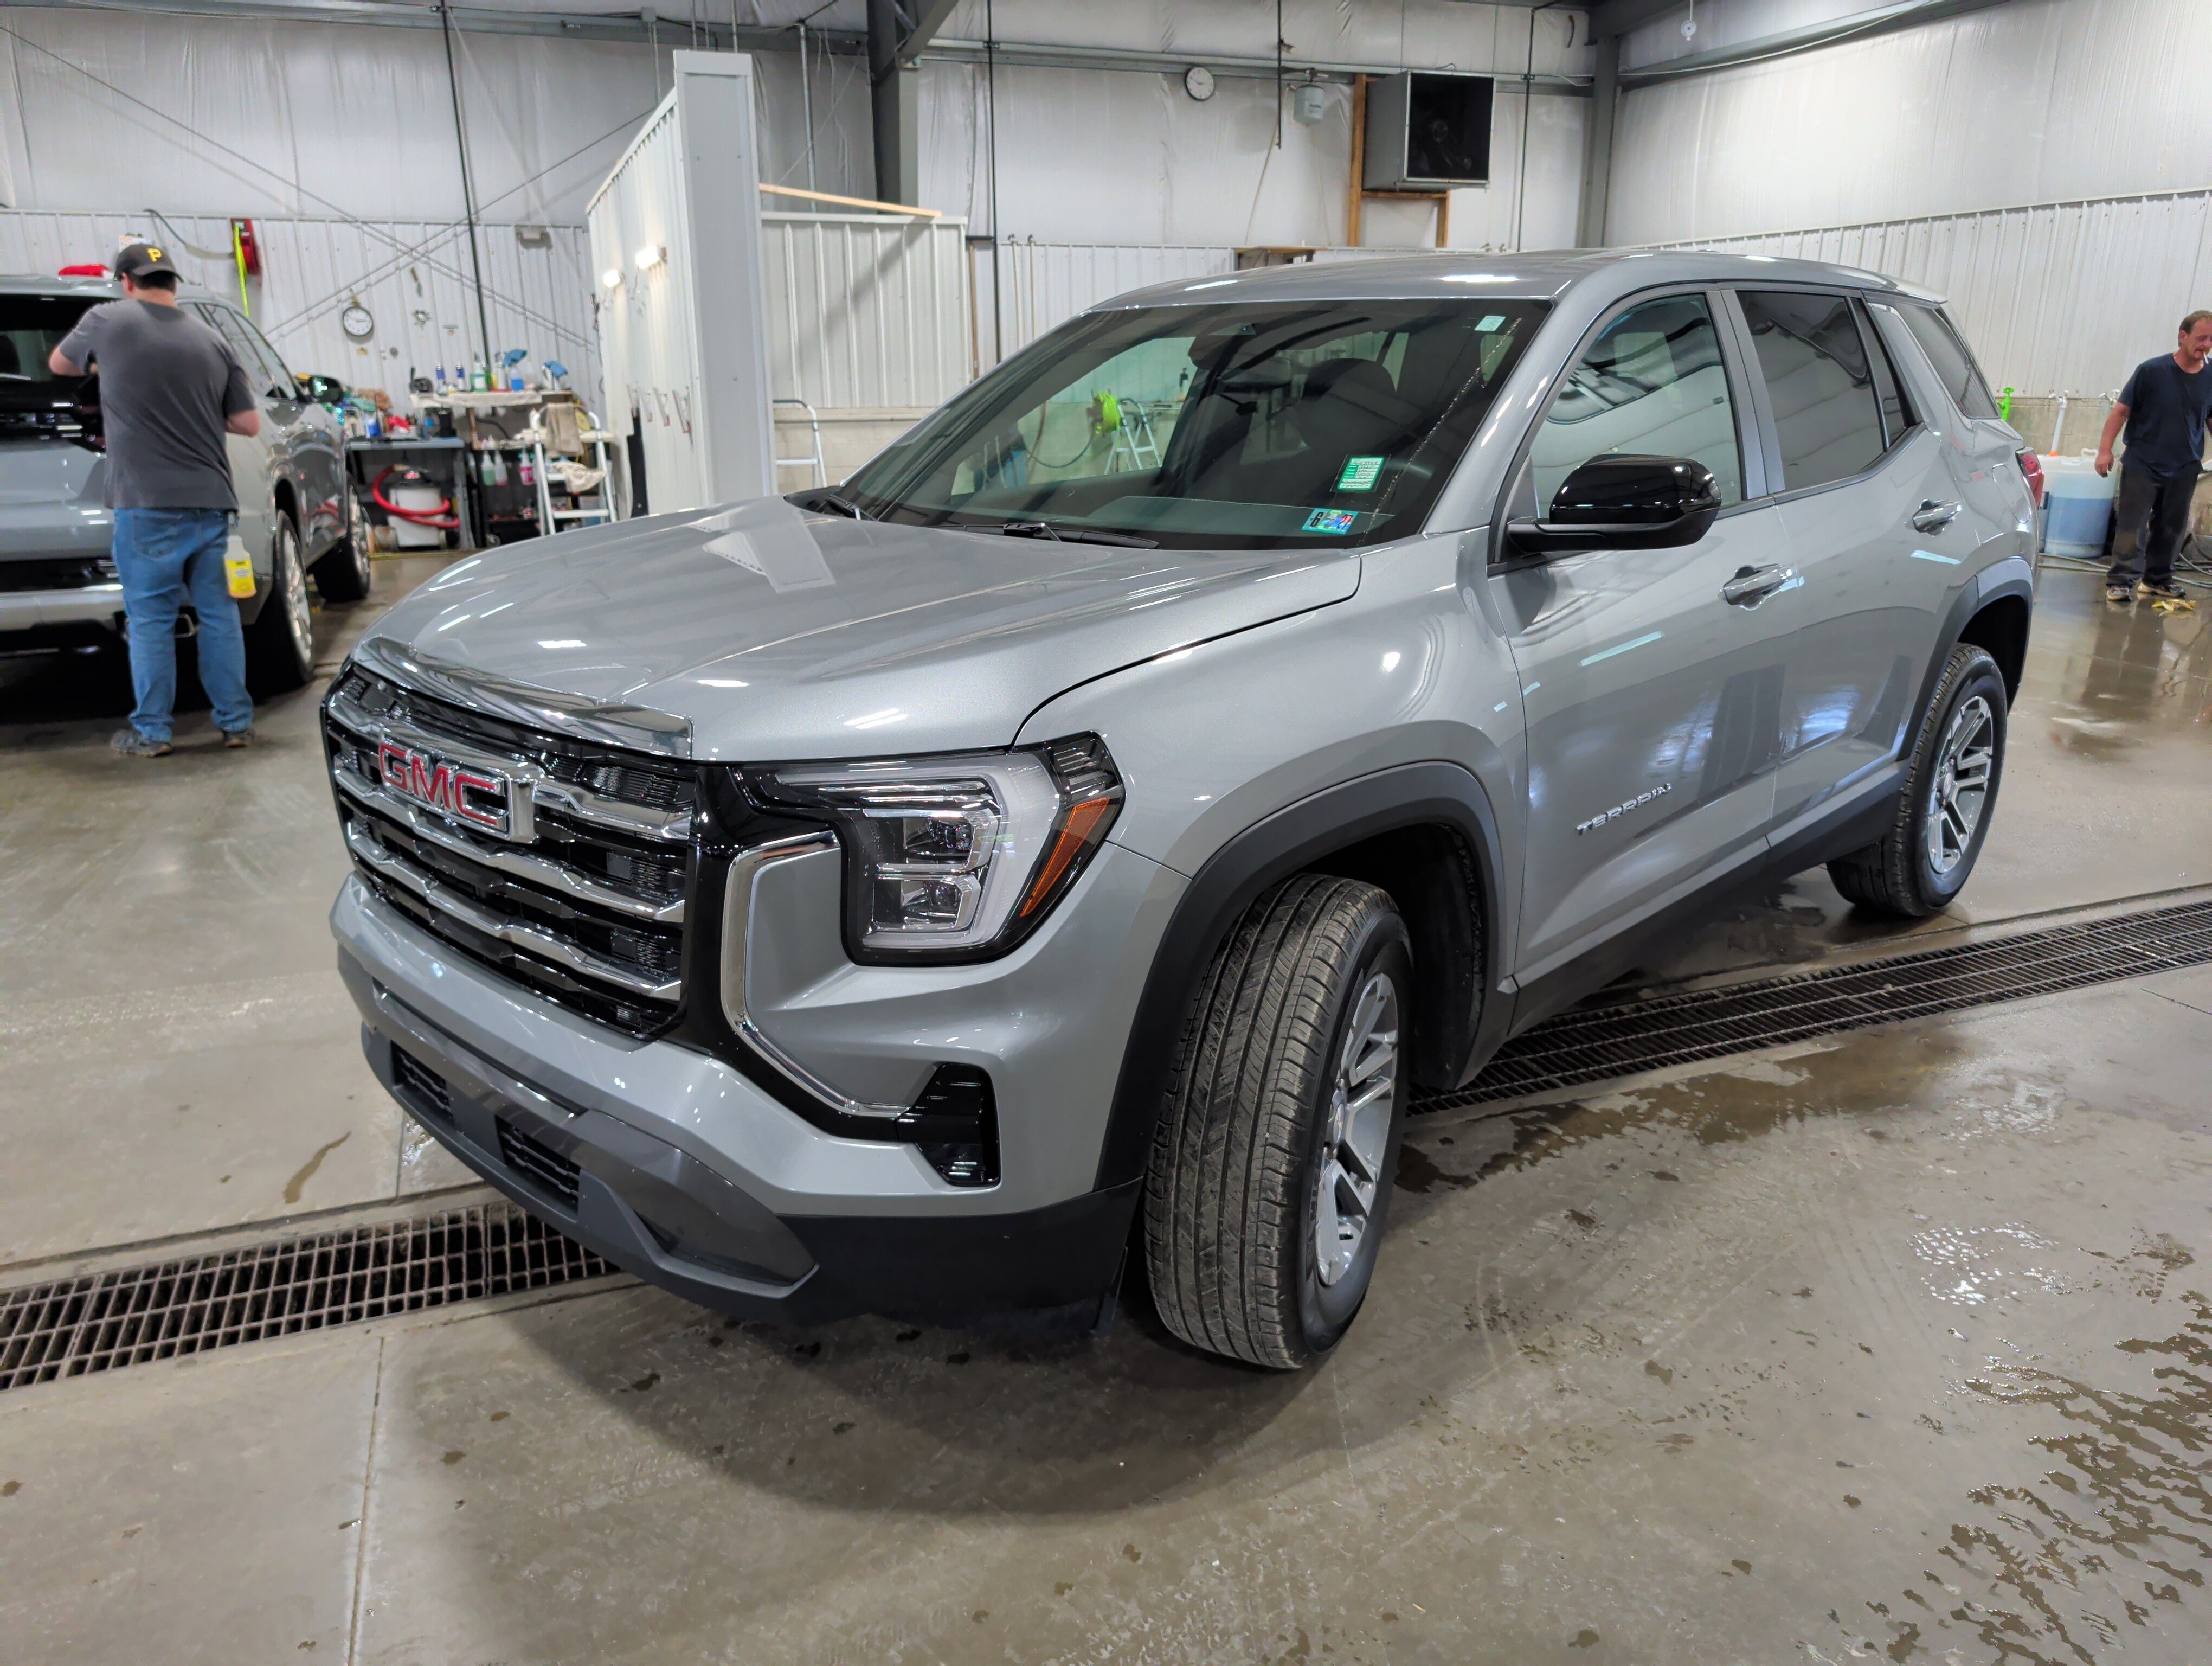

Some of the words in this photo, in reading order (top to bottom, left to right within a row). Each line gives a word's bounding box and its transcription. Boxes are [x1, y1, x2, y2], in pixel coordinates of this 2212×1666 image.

[147, 248, 163, 262] P
[1310, 511, 1324, 527] 6
[379, 742, 500, 826] GMC
[1576, 783, 1671, 834] TERRAIN
